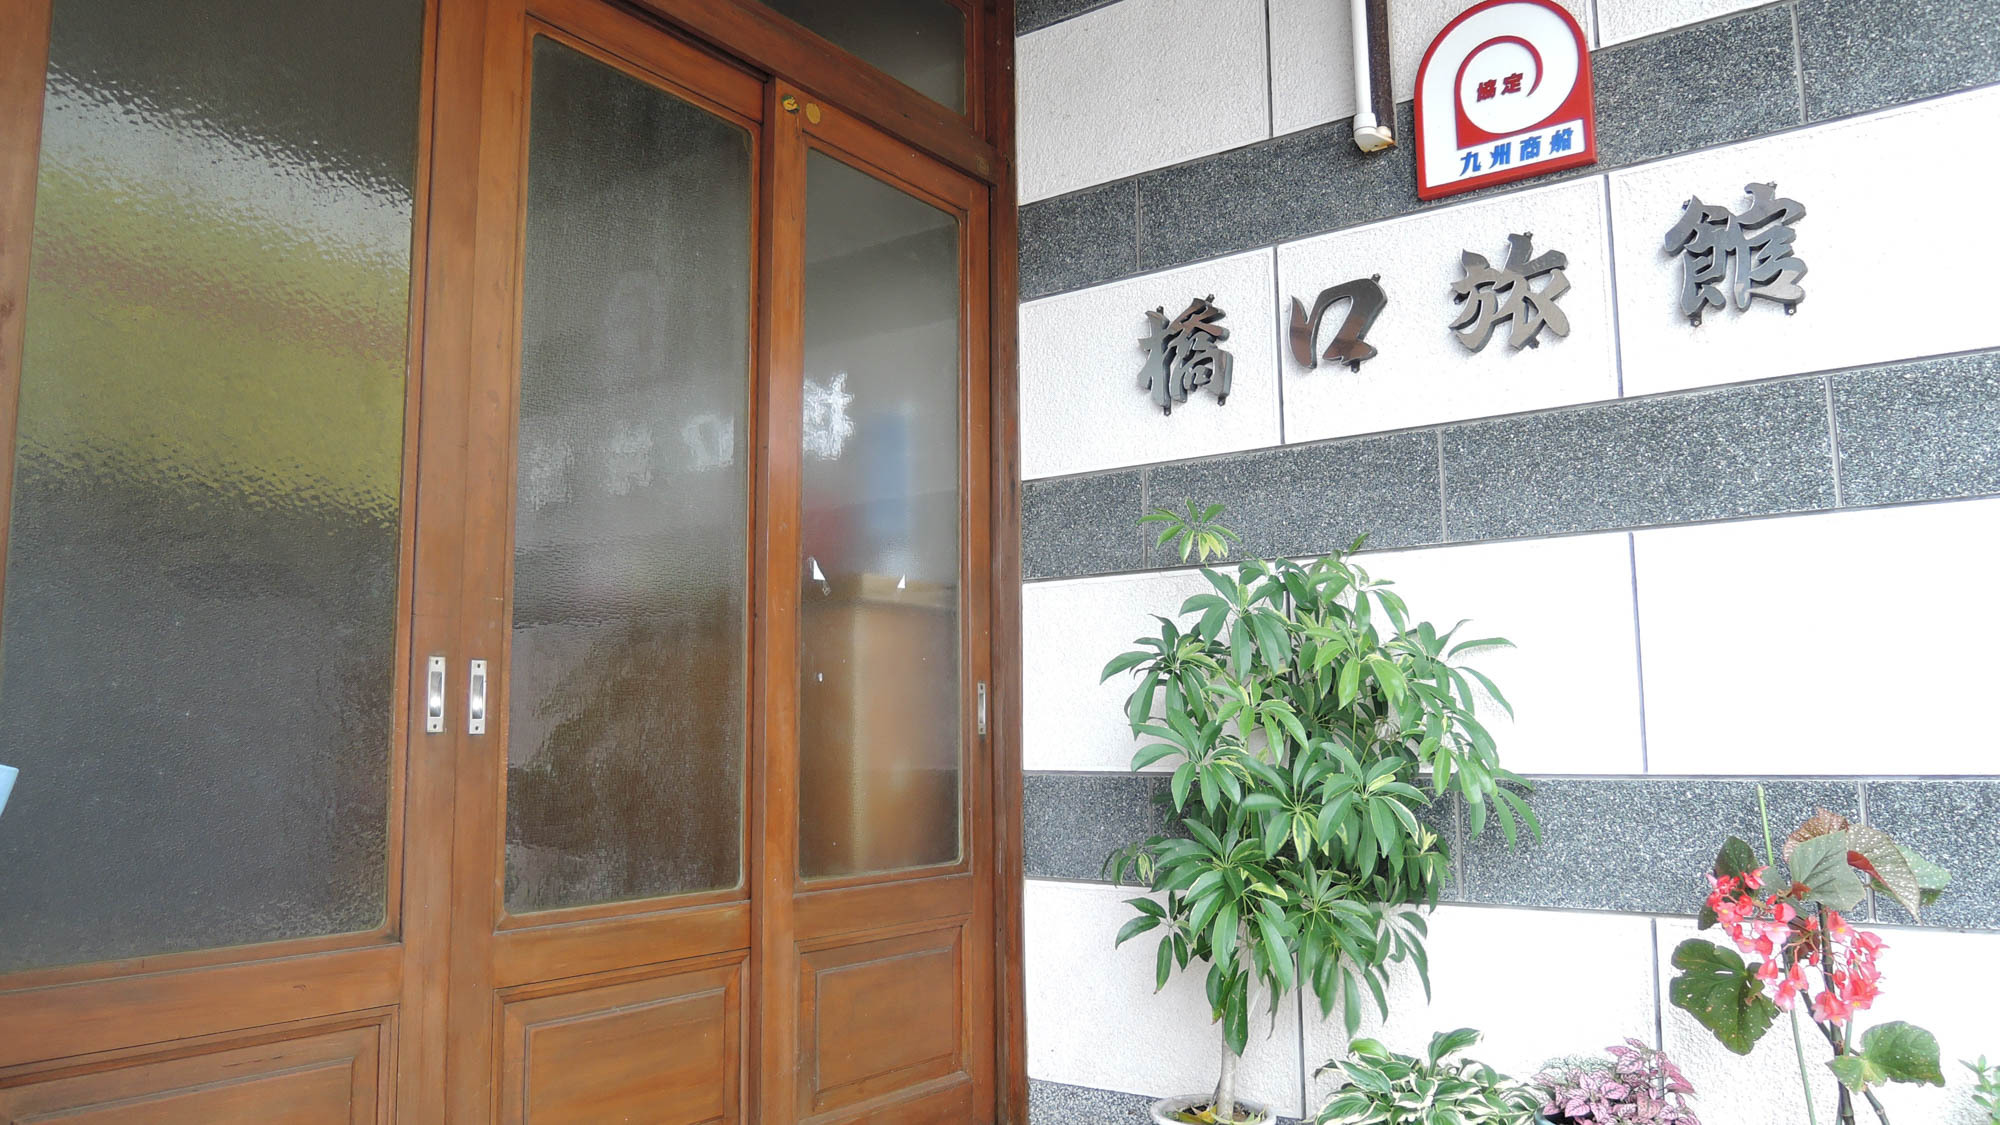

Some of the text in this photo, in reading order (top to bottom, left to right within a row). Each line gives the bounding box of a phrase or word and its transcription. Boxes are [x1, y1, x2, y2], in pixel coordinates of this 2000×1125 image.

[1460, 128, 1573, 176] 九州商船
[1137, 183, 1808, 415] 橋口旅館
